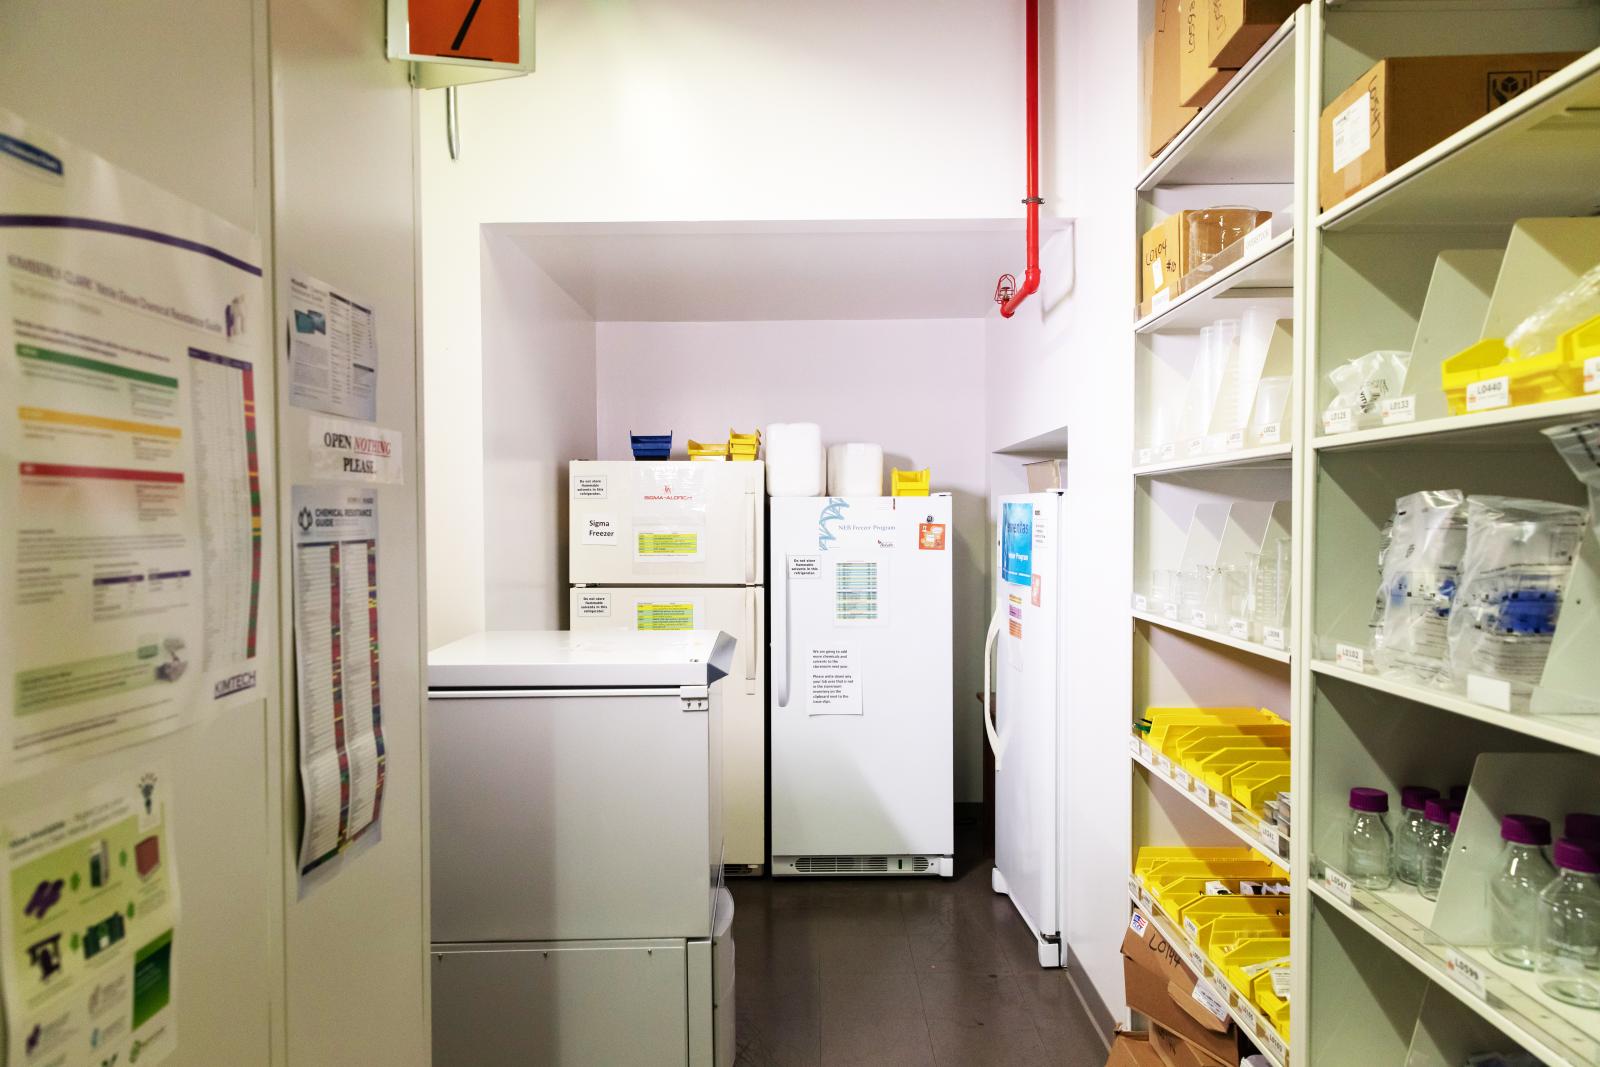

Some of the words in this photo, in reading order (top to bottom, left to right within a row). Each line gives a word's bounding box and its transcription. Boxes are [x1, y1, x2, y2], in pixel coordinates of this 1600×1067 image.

[1477, 382, 1502, 395] L0440
[323, 432, 352, 449] OPEN
[353, 437, 391, 458] NOTHING
[315, 519, 333, 527] GUIDE
[589, 520, 610, 528] Sigma
[214, 671, 257, 697] KIMTECH
